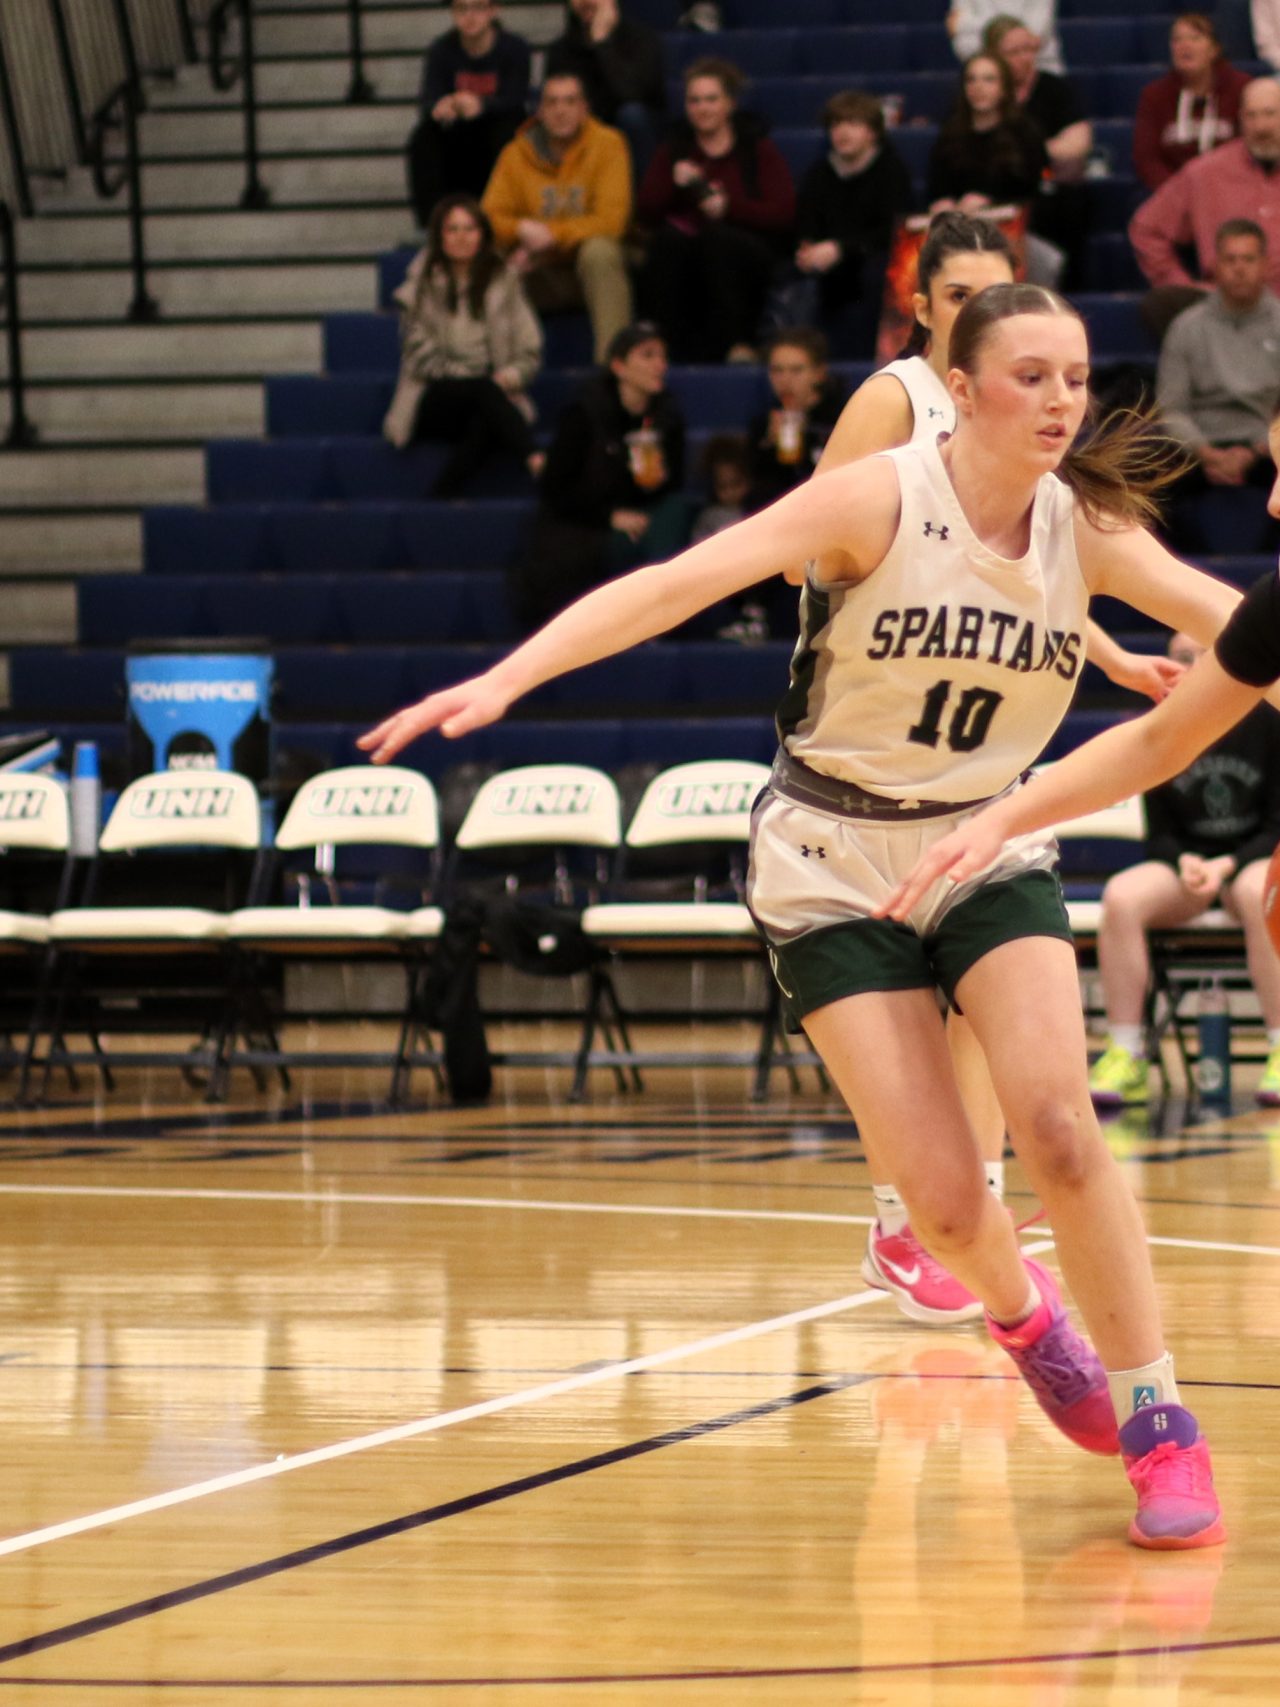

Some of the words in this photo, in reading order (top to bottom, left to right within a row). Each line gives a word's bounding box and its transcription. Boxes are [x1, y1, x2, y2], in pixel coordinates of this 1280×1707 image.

[867, 605, 1081, 681] SPARTANS
[907, 679, 1005, 753] 10
[130, 787, 235, 817] UNH
[309, 786, 414, 816] UNH
[492, 784, 595, 815] UNH
